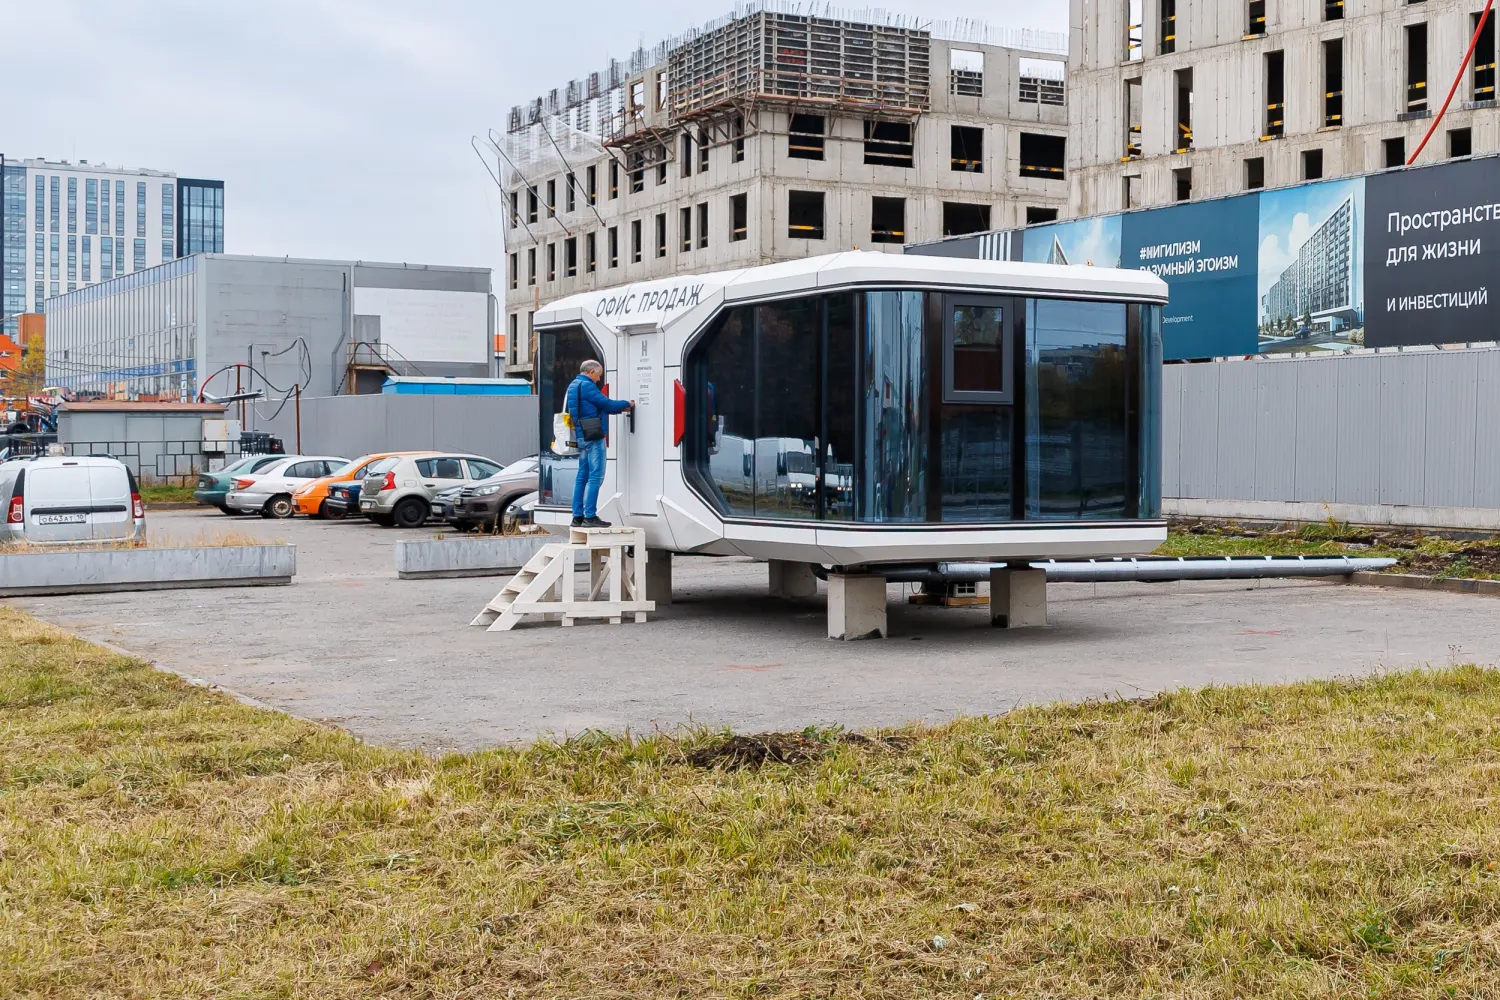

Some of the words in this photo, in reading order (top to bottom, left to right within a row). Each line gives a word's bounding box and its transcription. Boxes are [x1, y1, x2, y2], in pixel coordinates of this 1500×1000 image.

[1139, 240, 1201, 260] #НИГИЛИЗМ
[1386, 245, 1417, 267] для
[1422, 238, 1481, 261] жизни
[1196, 254, 1239, 273] ЭГОИЗМ
[595, 294, 636, 318] ОФИС
[637, 283, 705, 313] ПРОДАЖ
[1387, 297, 1396, 312] И
[1399, 286, 1488, 311] ИНВЕСТИЦИЙ
